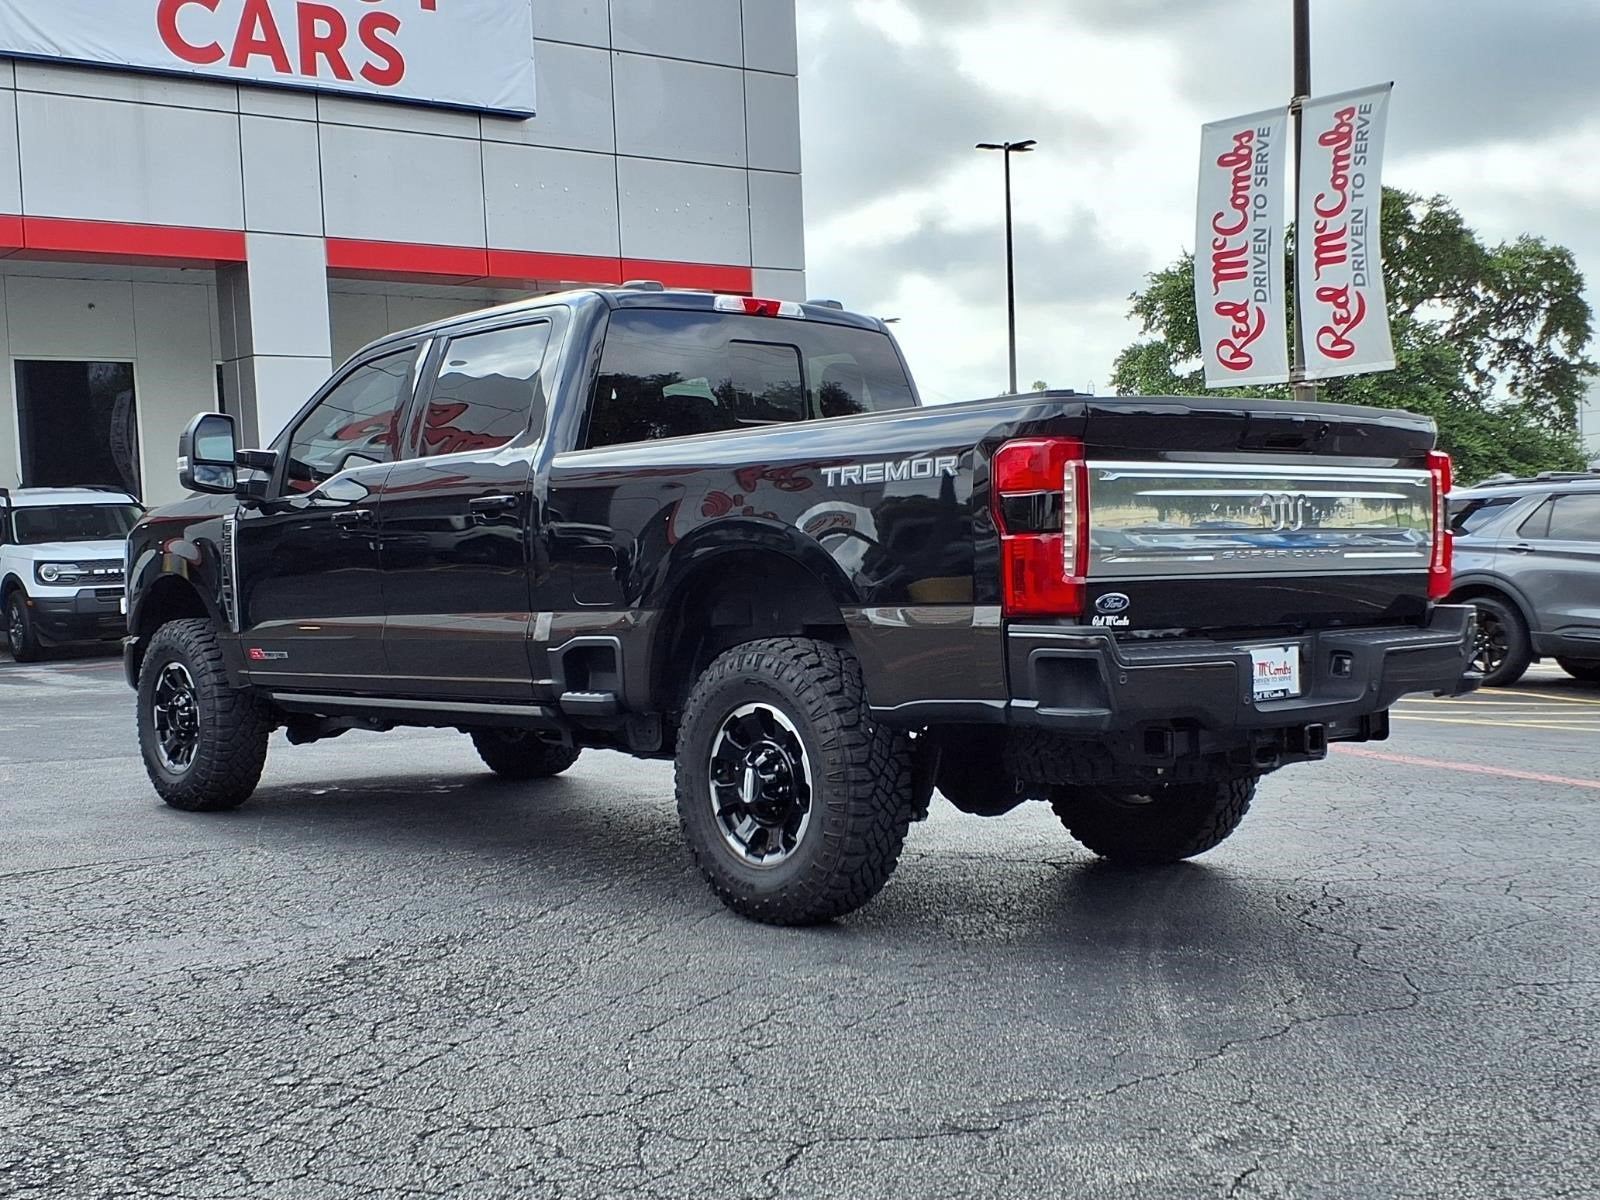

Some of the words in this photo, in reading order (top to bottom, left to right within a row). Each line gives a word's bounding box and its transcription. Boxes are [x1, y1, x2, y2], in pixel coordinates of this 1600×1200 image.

[157, 0, 405, 87] CARS
[1254, 126, 1271, 188] SERVE
[1352, 102, 1373, 166] SERVE
[1212, 128, 1255, 296] McCombs
[1253, 193, 1268, 223] TO
[1313, 105, 1356, 281] McCombs
[1352, 173, 1366, 203] TO
[1254, 227, 1268, 303] DRIVEN
[1352, 208, 1366, 288] DRIVEN
[1214, 299, 1265, 372] Red
[1316, 283, 1366, 360] Red
[820, 455, 959, 488] TREMOR
[1222, 549, 1290, 560] SUPER
[1292, 548, 1341, 558] DUTY
[1255, 660, 1292, 677] McCombs
